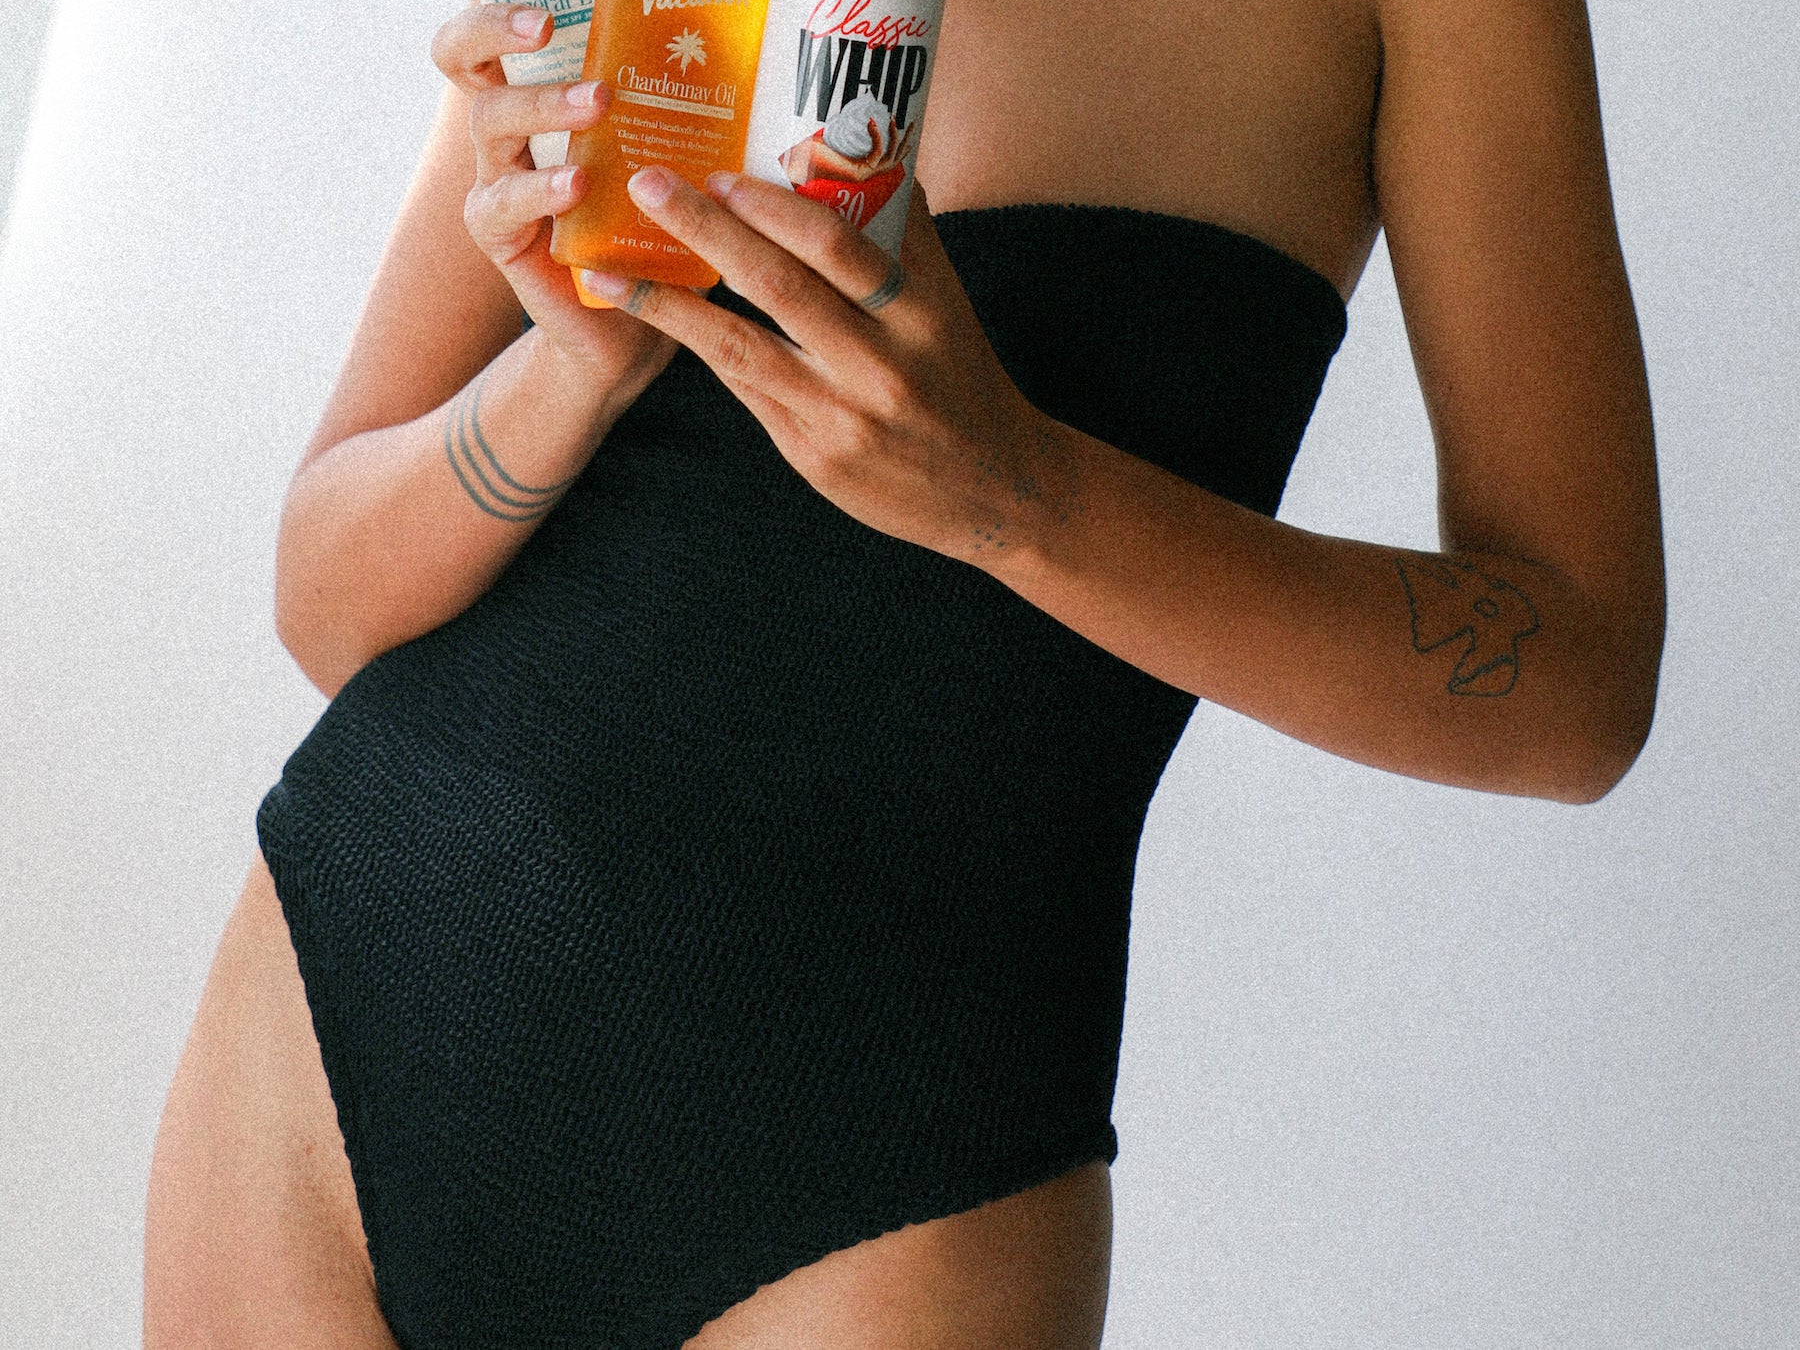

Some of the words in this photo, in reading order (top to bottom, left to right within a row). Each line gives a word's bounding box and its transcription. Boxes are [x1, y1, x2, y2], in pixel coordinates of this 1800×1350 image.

[617, 65, 712, 104] Chardonnay
[715, 82, 737, 107] Oil
[794, 28, 928, 130] WHIP
[612, 235, 625, 245] 3.4
[628, 238, 637, 248] FL
[640, 240, 654, 251] OZ
[663, 244, 677, 254] 100
